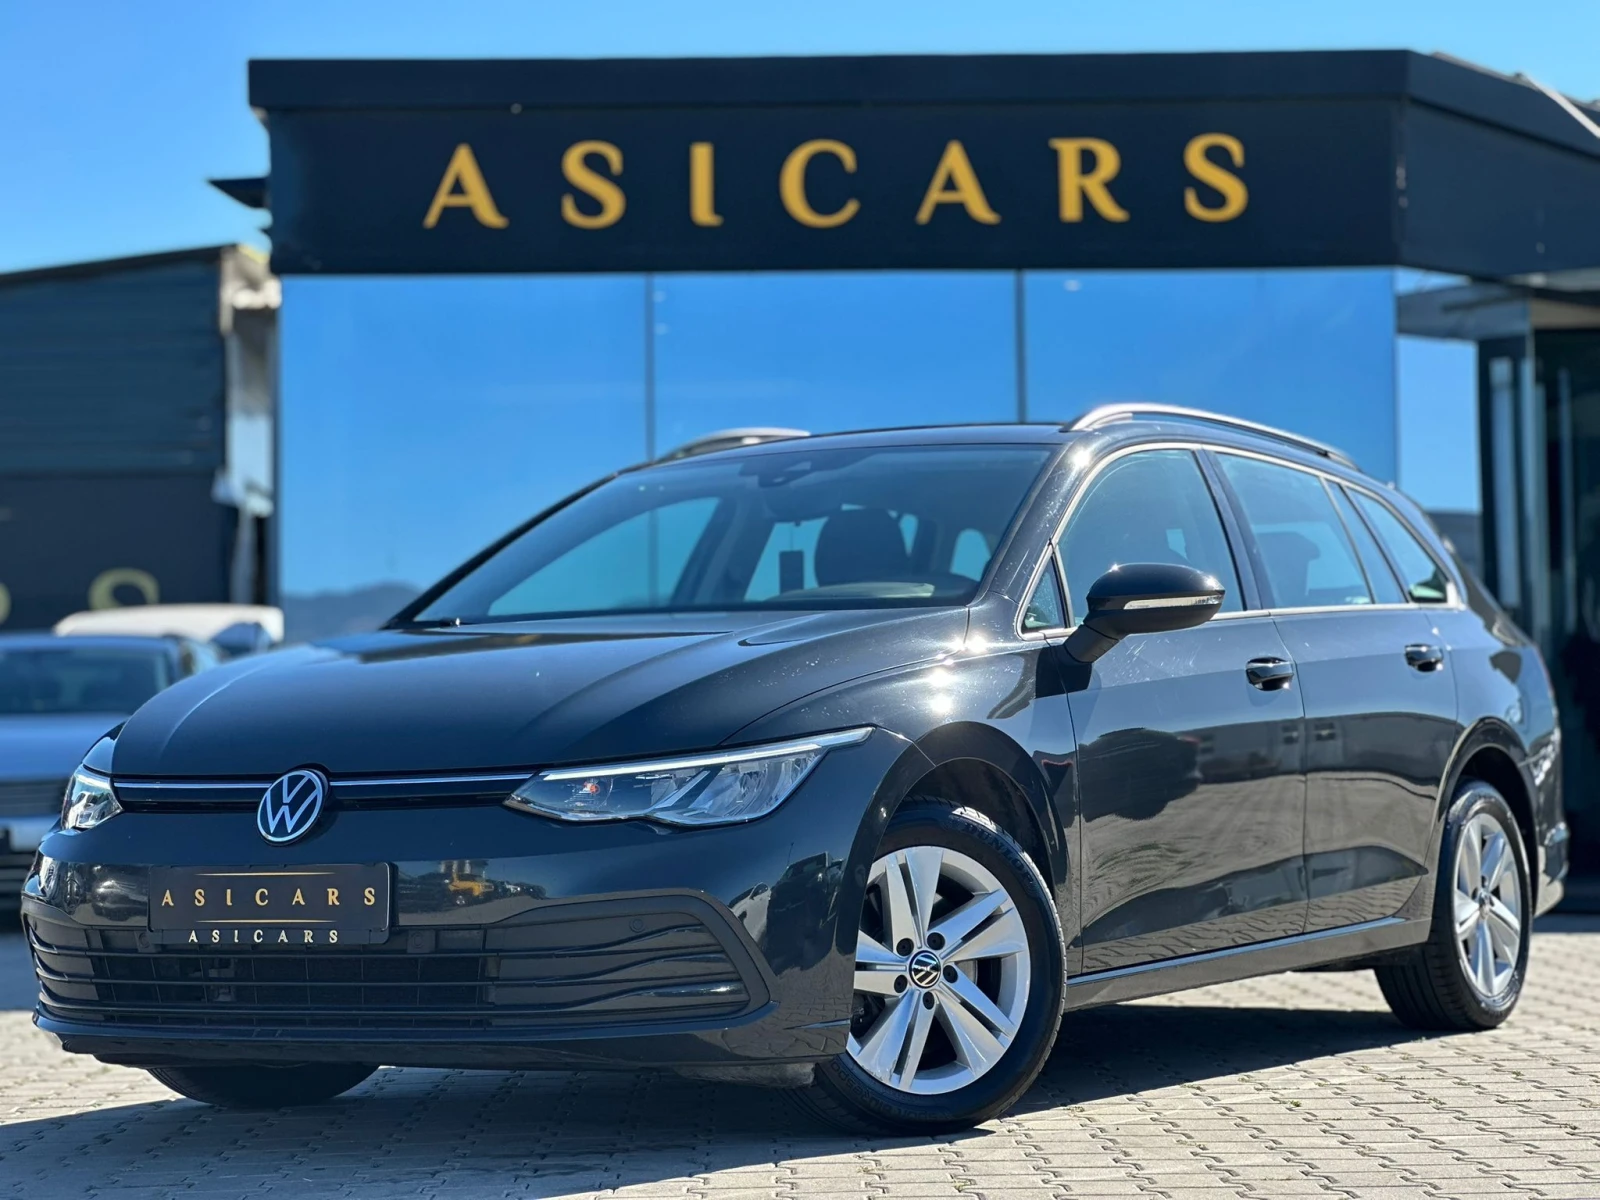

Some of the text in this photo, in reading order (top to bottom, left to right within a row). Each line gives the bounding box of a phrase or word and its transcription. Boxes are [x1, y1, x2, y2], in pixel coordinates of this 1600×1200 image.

[423, 132, 1249, 229] ASICARS
[161, 887, 376, 907] ASICARS
[188, 929, 338, 943] ASICARS
